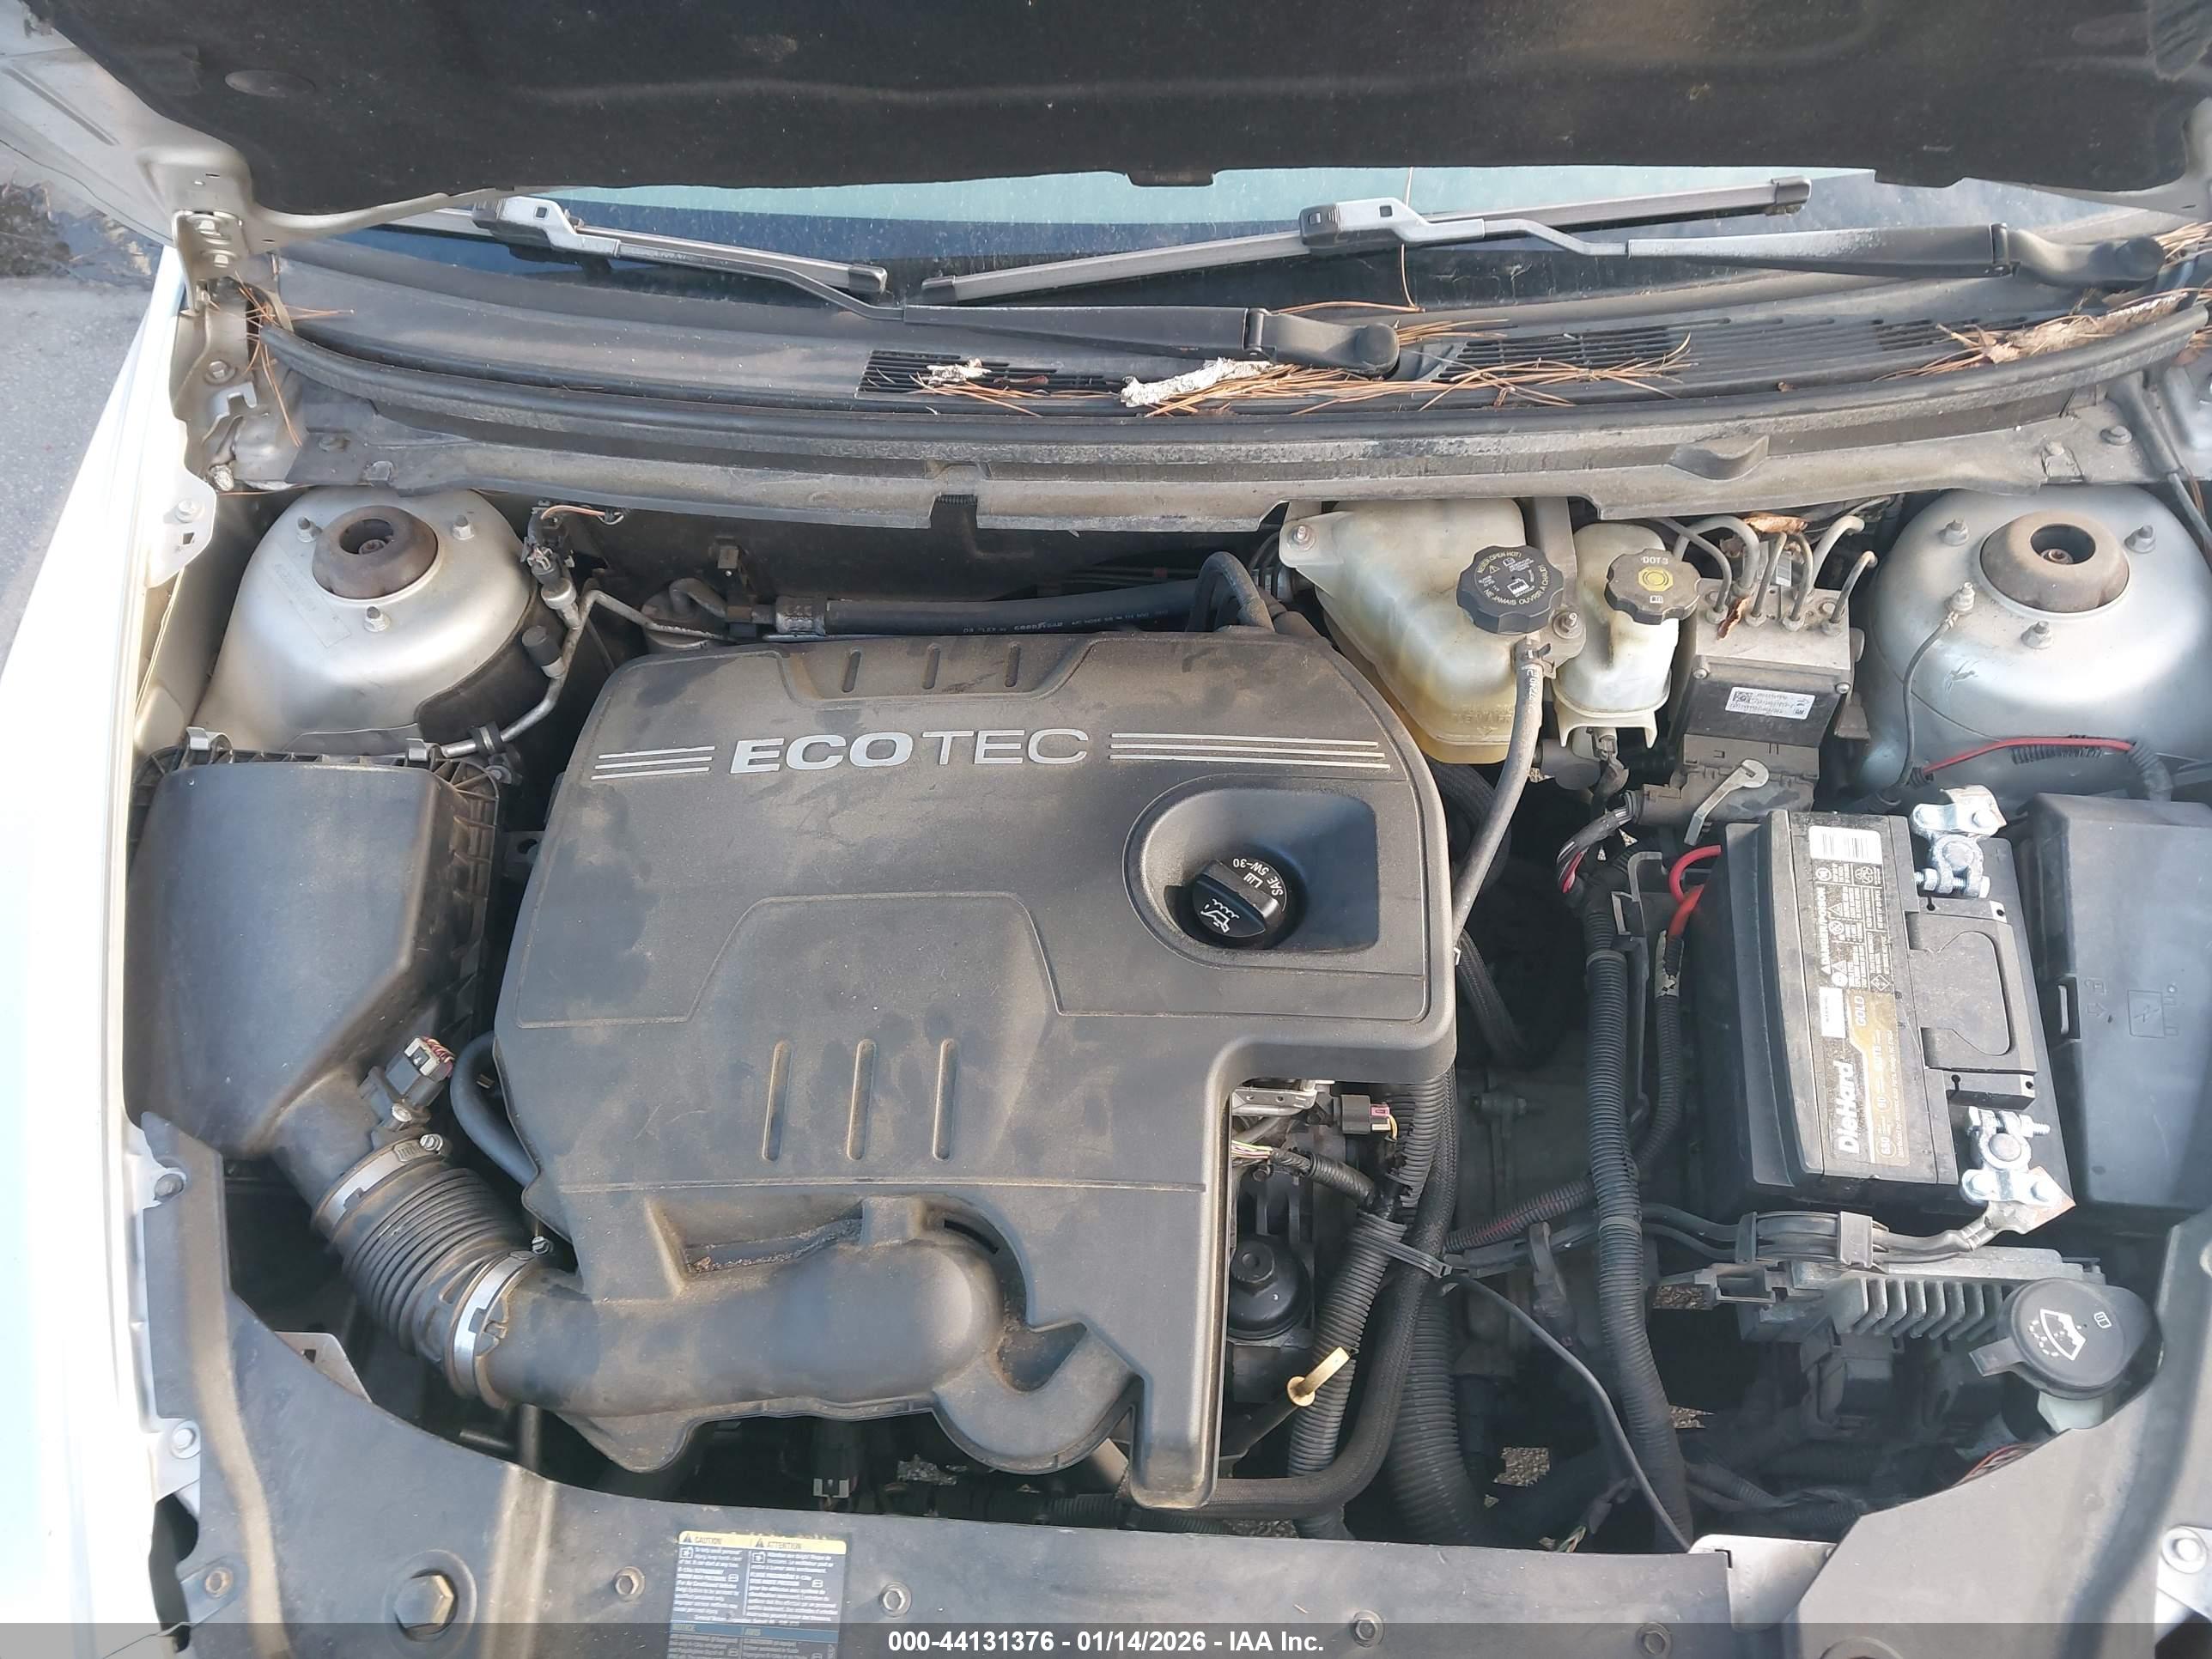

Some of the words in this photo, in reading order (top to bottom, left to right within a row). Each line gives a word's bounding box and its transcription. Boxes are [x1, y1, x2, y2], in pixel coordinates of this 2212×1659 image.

[1642, 556, 1661, 564] DOT
[1493, 596, 1517, 605] JAMAIS
[731, 728, 1090, 775] ECOTEC
[1232, 858, 1270, 876] 5W-30
[1267, 875, 1284, 896] SAE
[1853, 995, 1867, 1027] GOLD
[1832, 1059, 1861, 1155] DieHard
